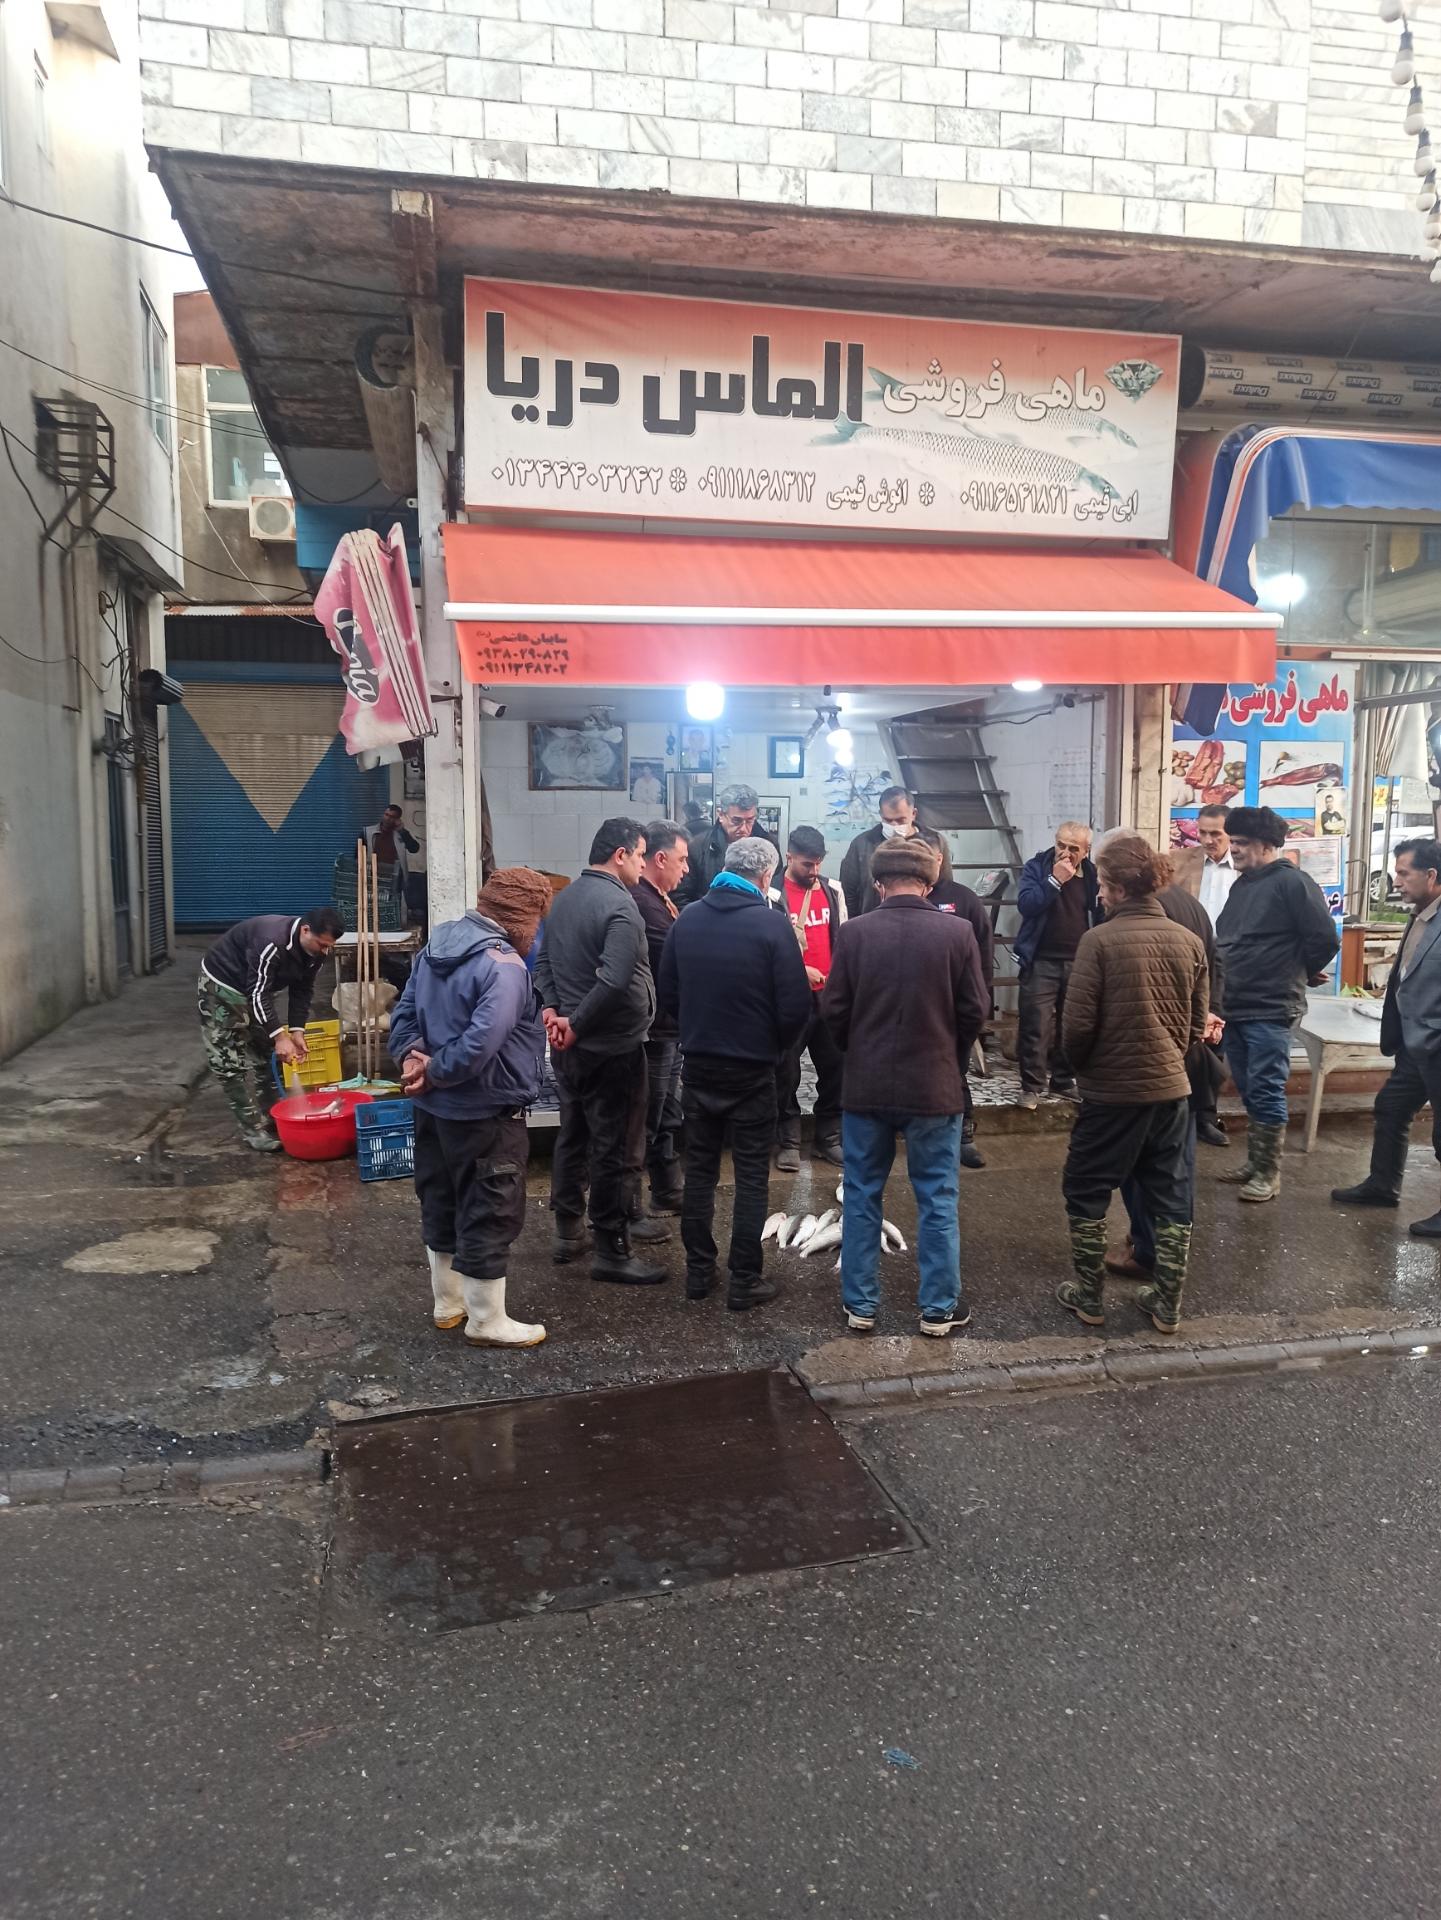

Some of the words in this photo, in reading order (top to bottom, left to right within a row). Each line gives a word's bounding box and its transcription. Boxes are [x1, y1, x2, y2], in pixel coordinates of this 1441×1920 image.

[485, 310, 621, 428] دریا
[642, 334, 865, 438] الماس
[883, 357, 1006, 418] فروشی
[1013, 366, 1106, 421] ماهی
[491, 458, 663, 495] ۰۱۳۴۴۴۰۳۲۴۲
[698, 464, 816, 503] ۰۹۱۱۱۸۶۸۳۱۲
[867, 478, 908, 513] انوش
[960, 481, 1068, 515] ۰۹۱۱۶۵۴۱۸۲۱
[1299, 673, 1348, 723] ماهی
